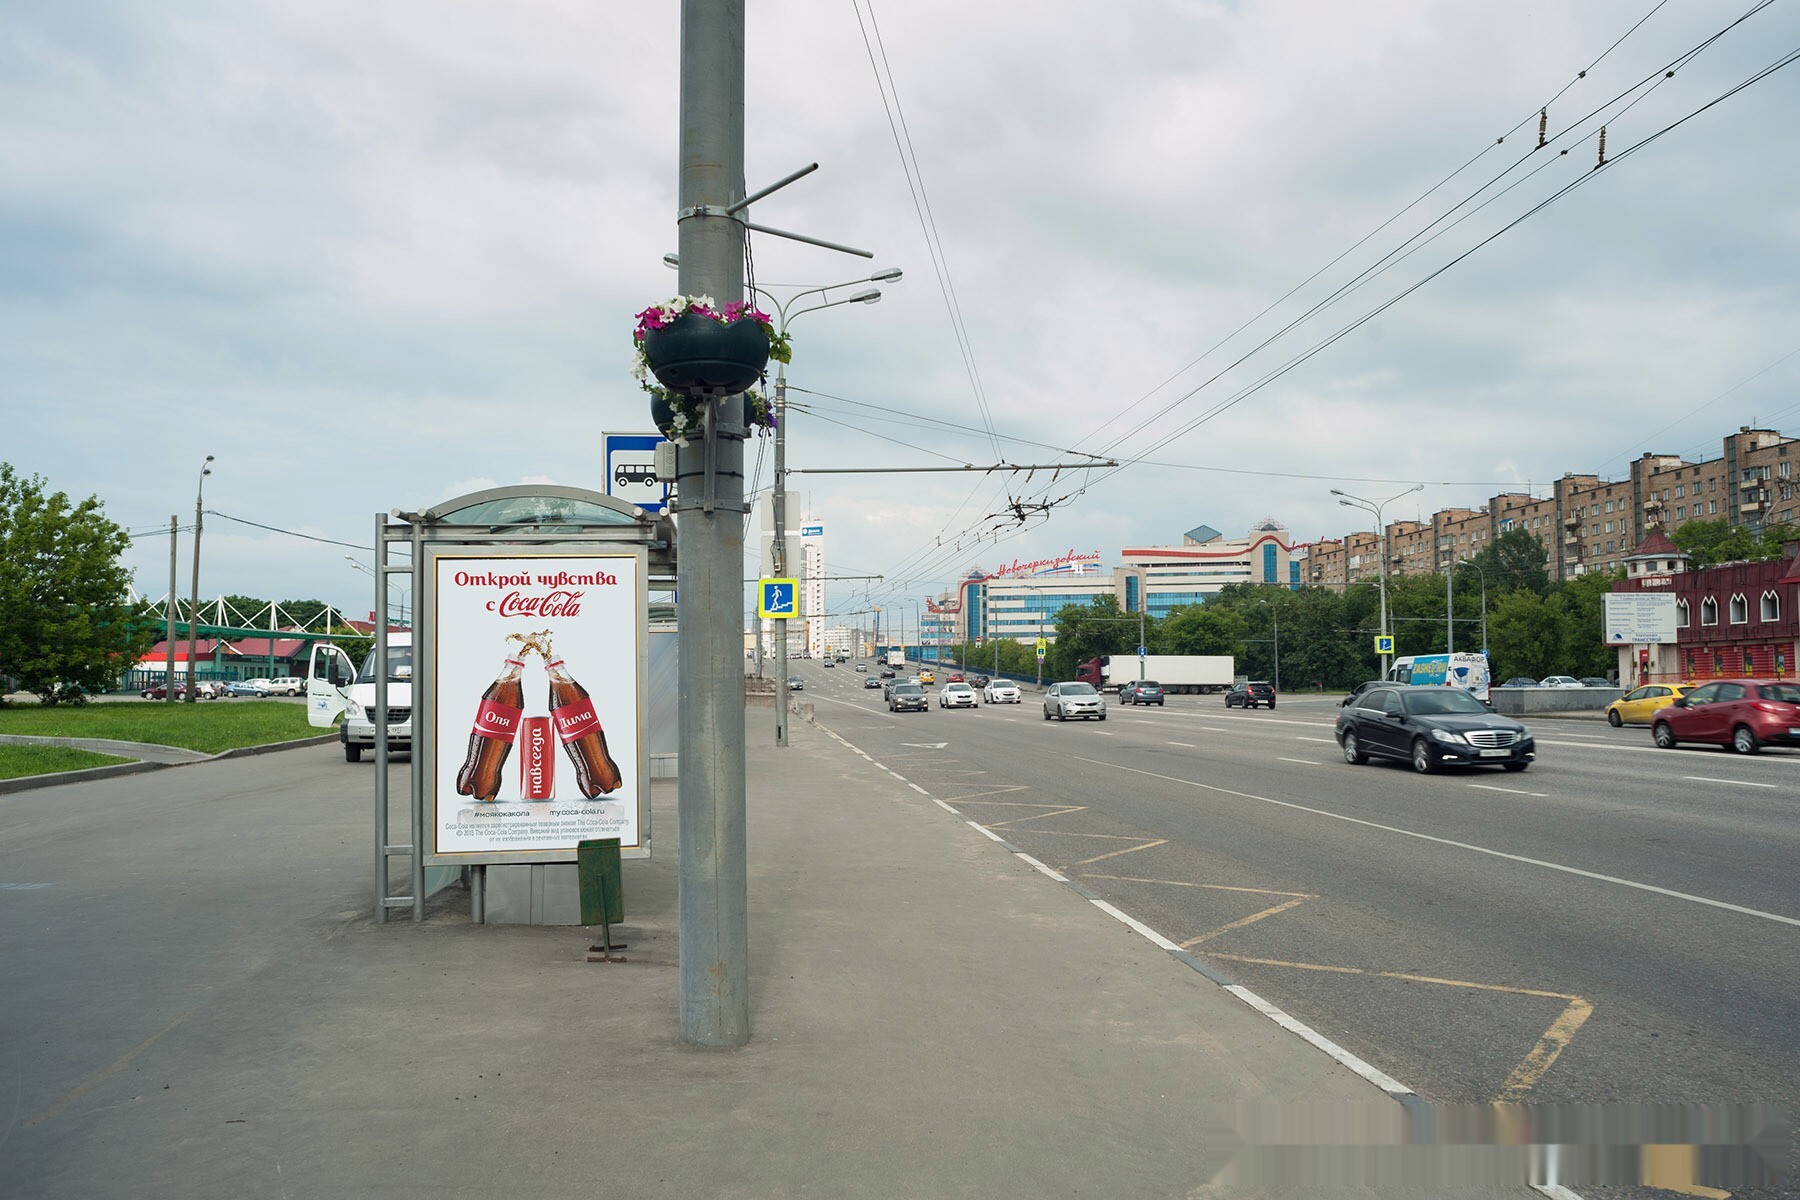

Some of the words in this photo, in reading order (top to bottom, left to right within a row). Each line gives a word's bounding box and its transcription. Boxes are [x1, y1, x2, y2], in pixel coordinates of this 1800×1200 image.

[454, 571, 532, 589] Открой
[537, 571, 618, 589] чувства
[485, 600, 496, 612] с
[499, 591, 586, 617] Coca-Cola
[485, 711, 510, 727] Оля
[560, 711, 593, 730] Дима
[529, 727, 545, 794] навсегда
